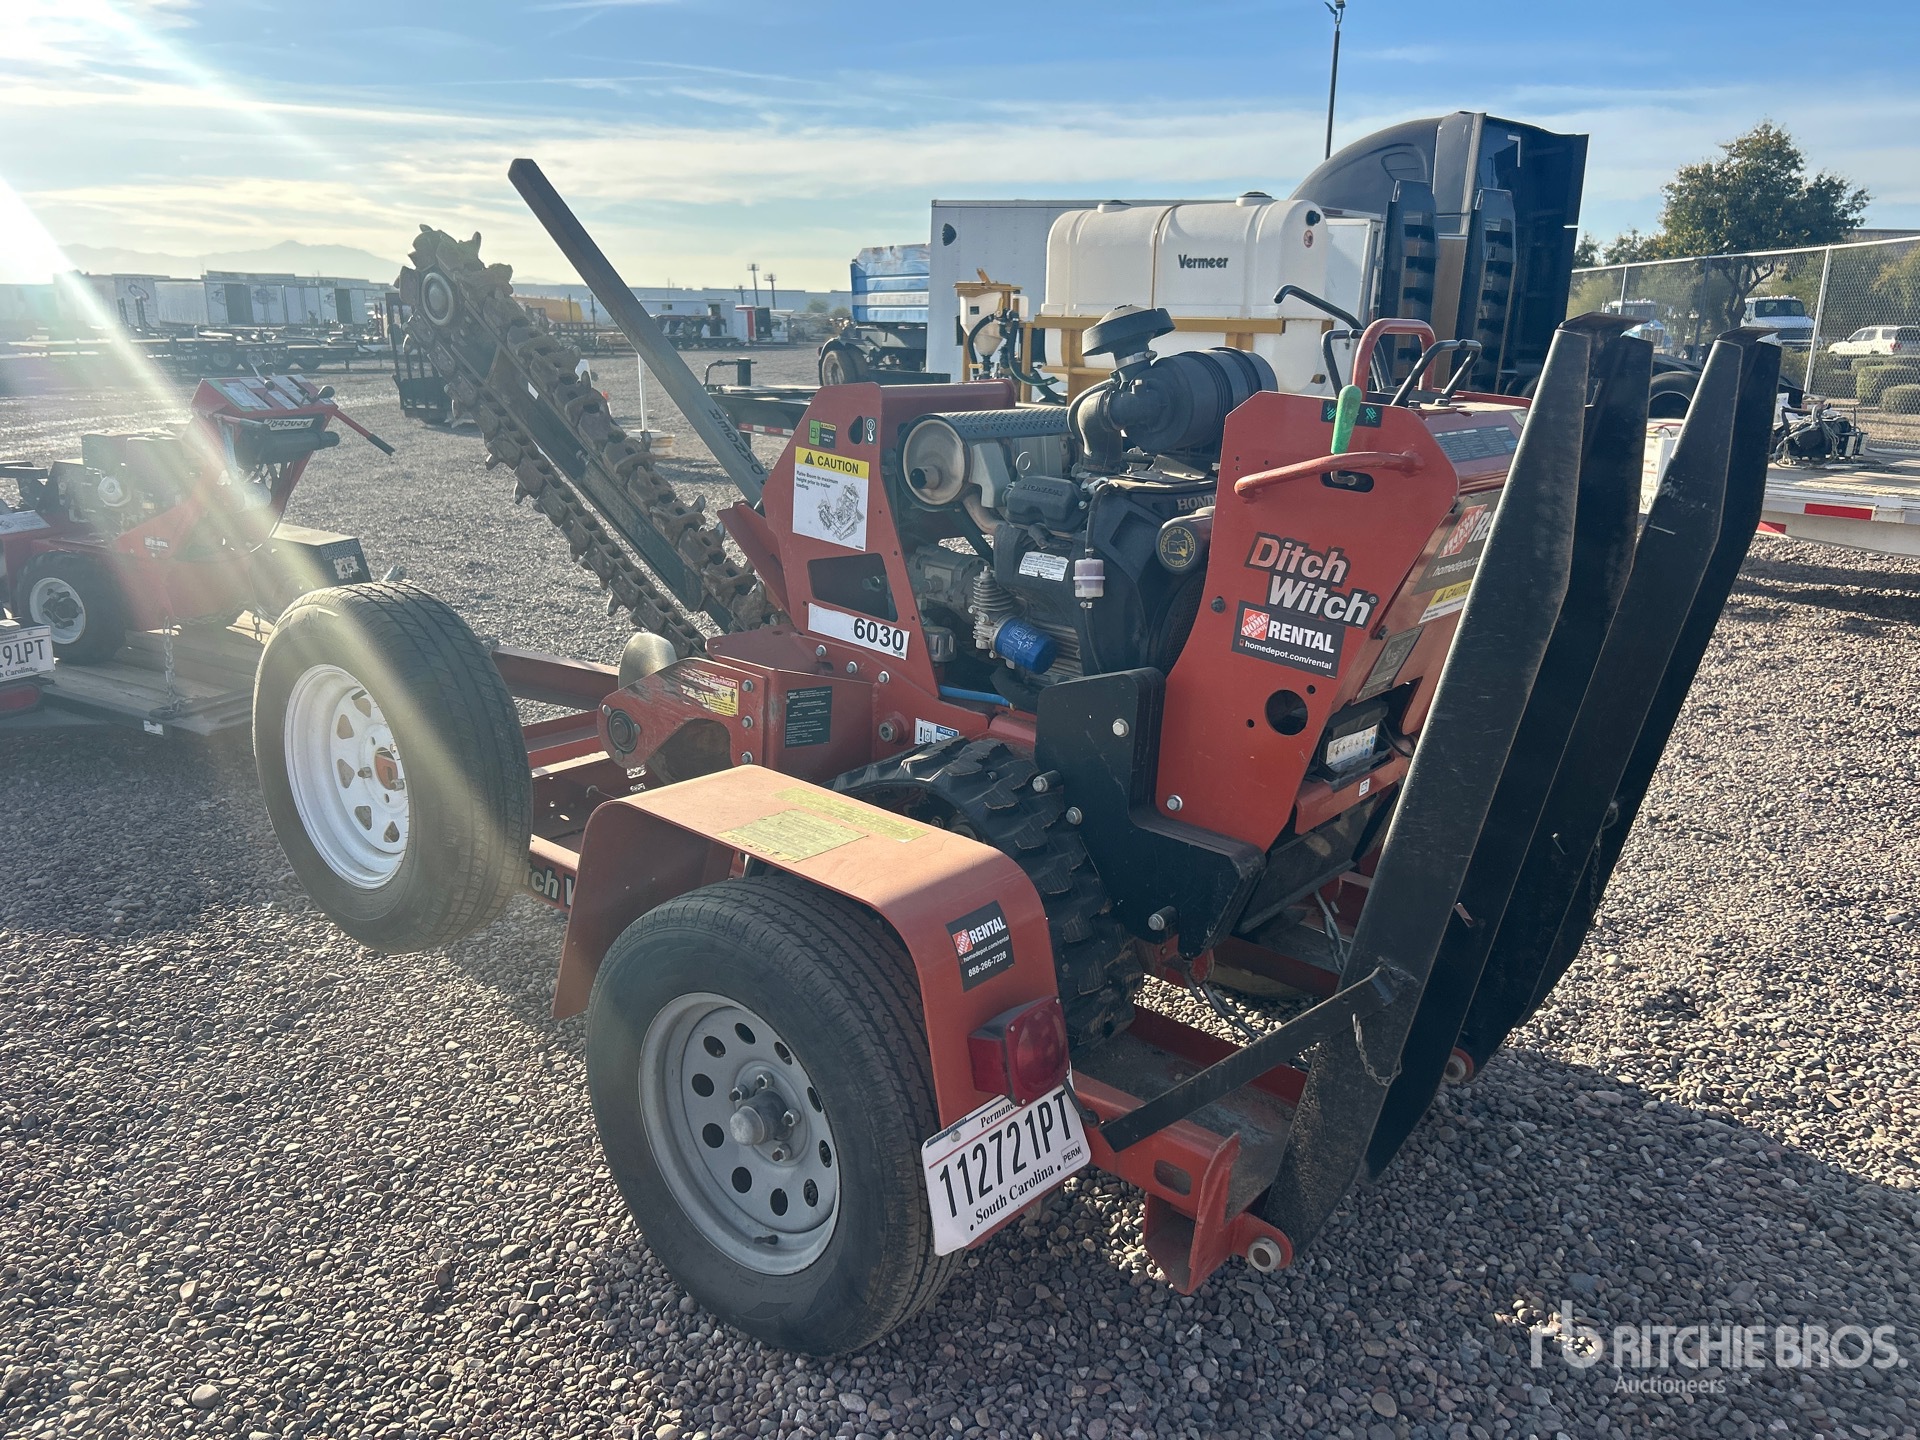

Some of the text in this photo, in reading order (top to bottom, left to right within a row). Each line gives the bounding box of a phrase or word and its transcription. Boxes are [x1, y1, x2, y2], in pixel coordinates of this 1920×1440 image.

[1178, 254, 1228, 268] Vermeer
[817, 455, 858, 475] CAUTION
[1176, 494, 1216, 511] HOND
[1249, 537, 1347, 583] Ditch
[853, 617, 904, 651] 6030
[1242, 613, 1335, 654] HOME RENTAL
[0, 638, 44, 668] 91PT
[1244, 640, 1332, 670] homedepot.com/rental
[939, 728, 955, 737] NOTICE
[969, 916, 1007, 945] RENTAL
[963, 934, 1010, 963] homedepot.com/rental
[968, 950, 1007, 978] 888-266-7228
[980, 1103, 1017, 1128] Permane
[939, 1089, 1072, 1218] 112721PT
[1063, 1146, 1082, 1163] PERM
[975, 1164, 1055, 1225] South Carolina
